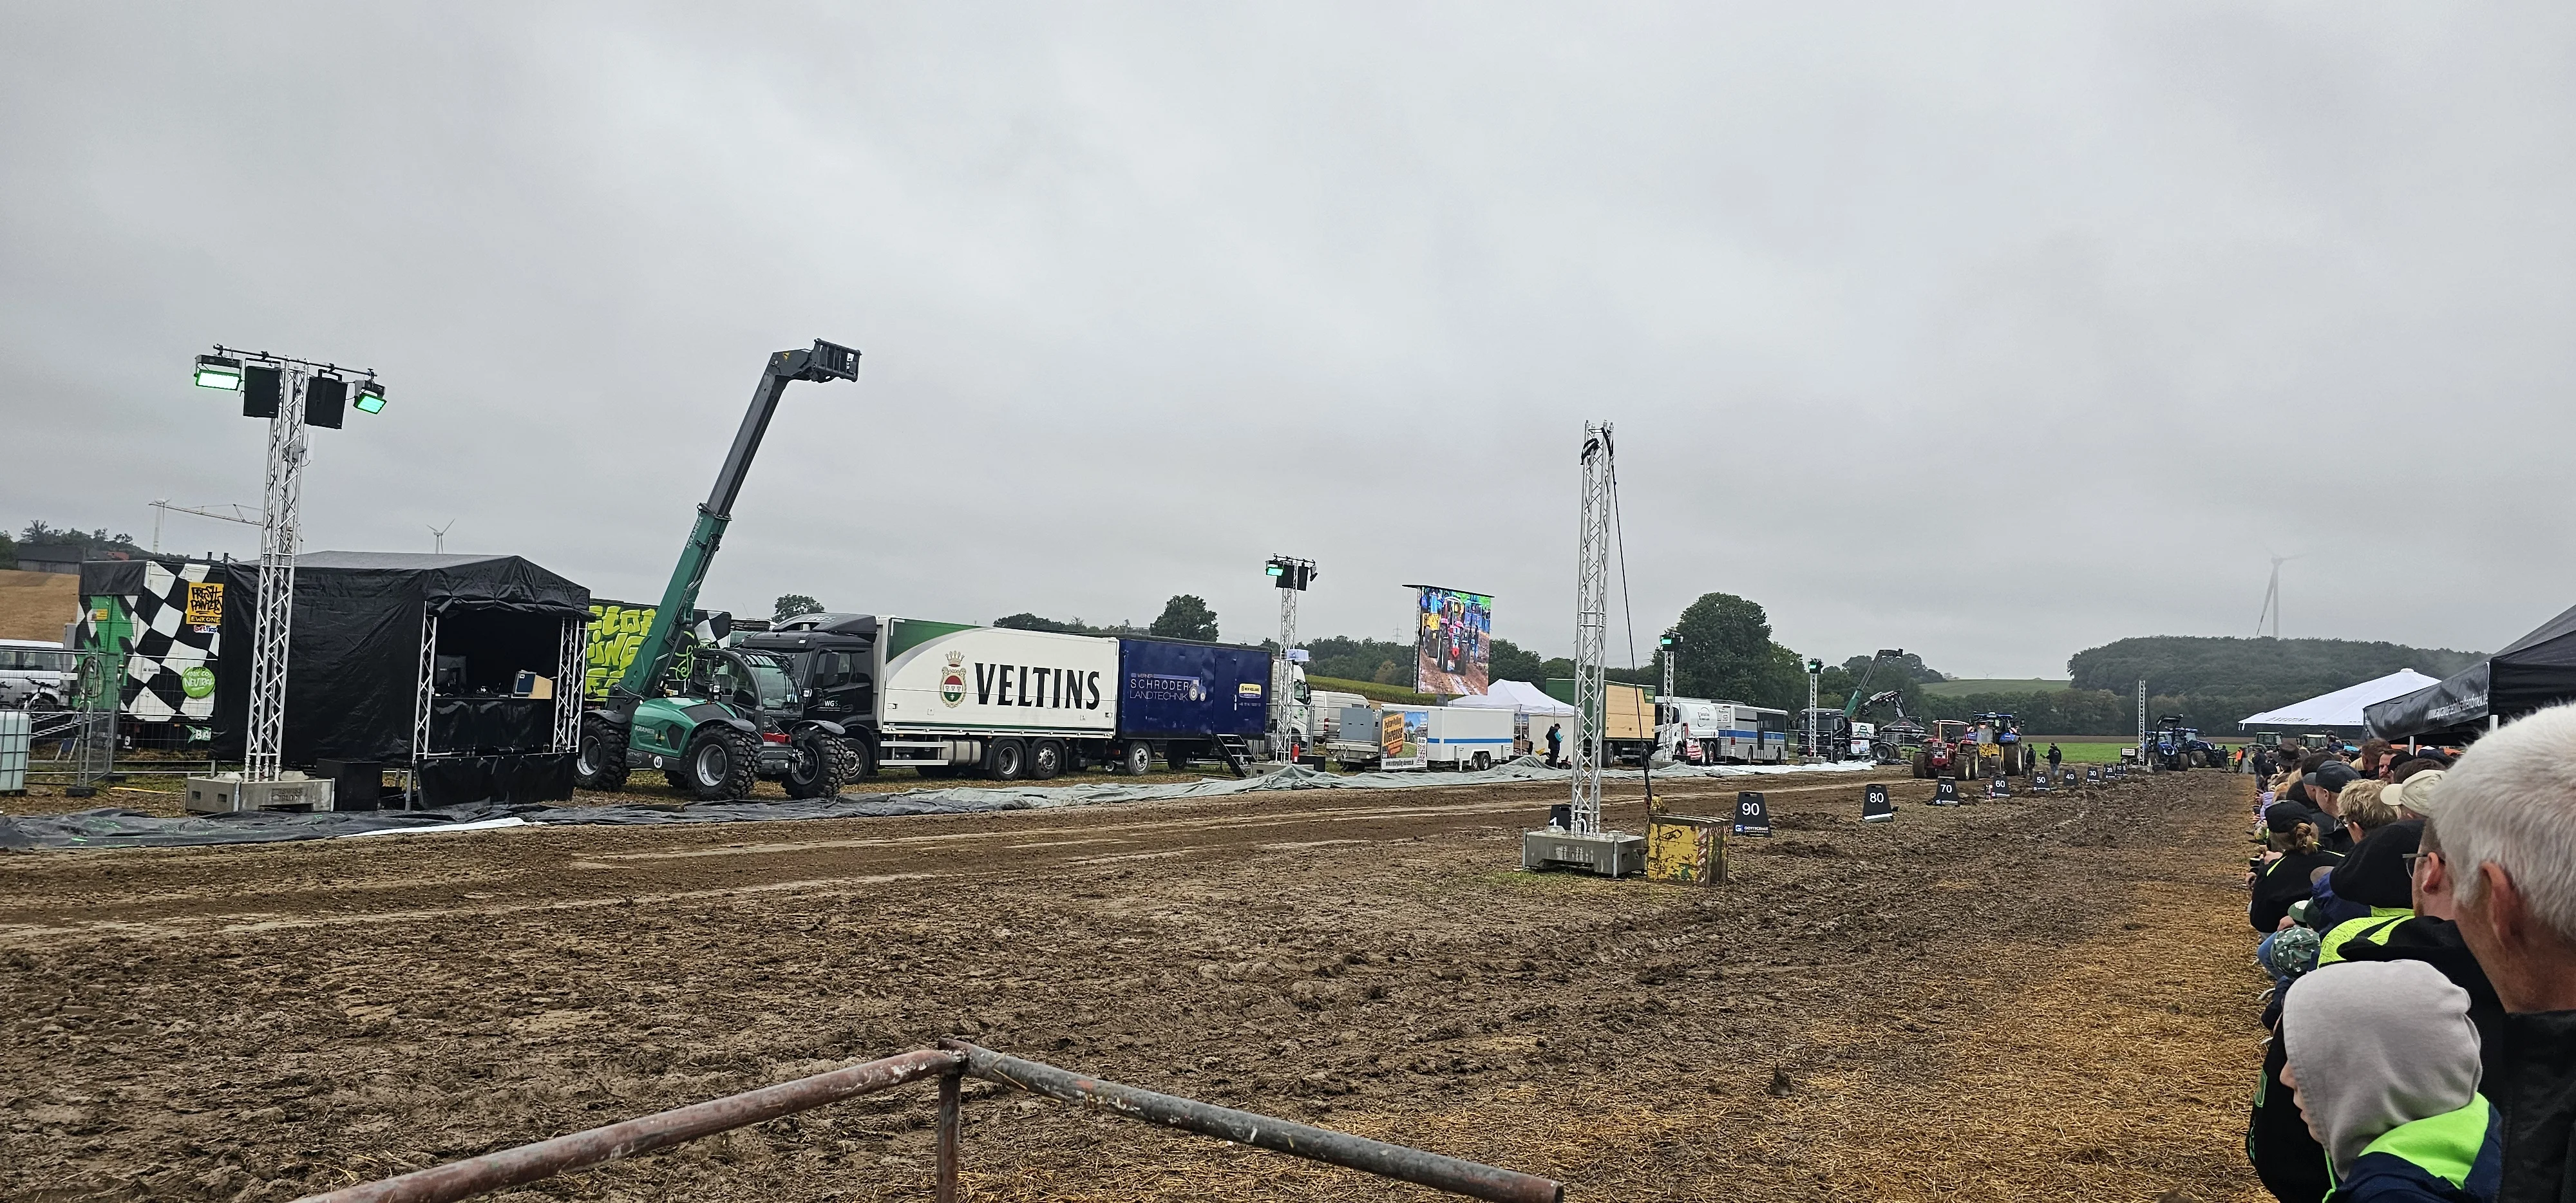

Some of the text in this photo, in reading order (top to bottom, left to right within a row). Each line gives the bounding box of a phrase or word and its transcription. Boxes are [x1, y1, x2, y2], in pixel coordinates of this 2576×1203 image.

[686, 516, 703, 549] KRAMER
[183, 677, 214, 687] NEUTRAL
[975, 663, 1099, 710] VELTINS
[1130, 690, 1188, 701] LANDTECHNIK
[634, 725, 655, 734] KRAMER
[1940, 784, 1953, 793] 70
[1870, 792, 1884, 803] 80
[1742, 802, 1760, 816] 90
